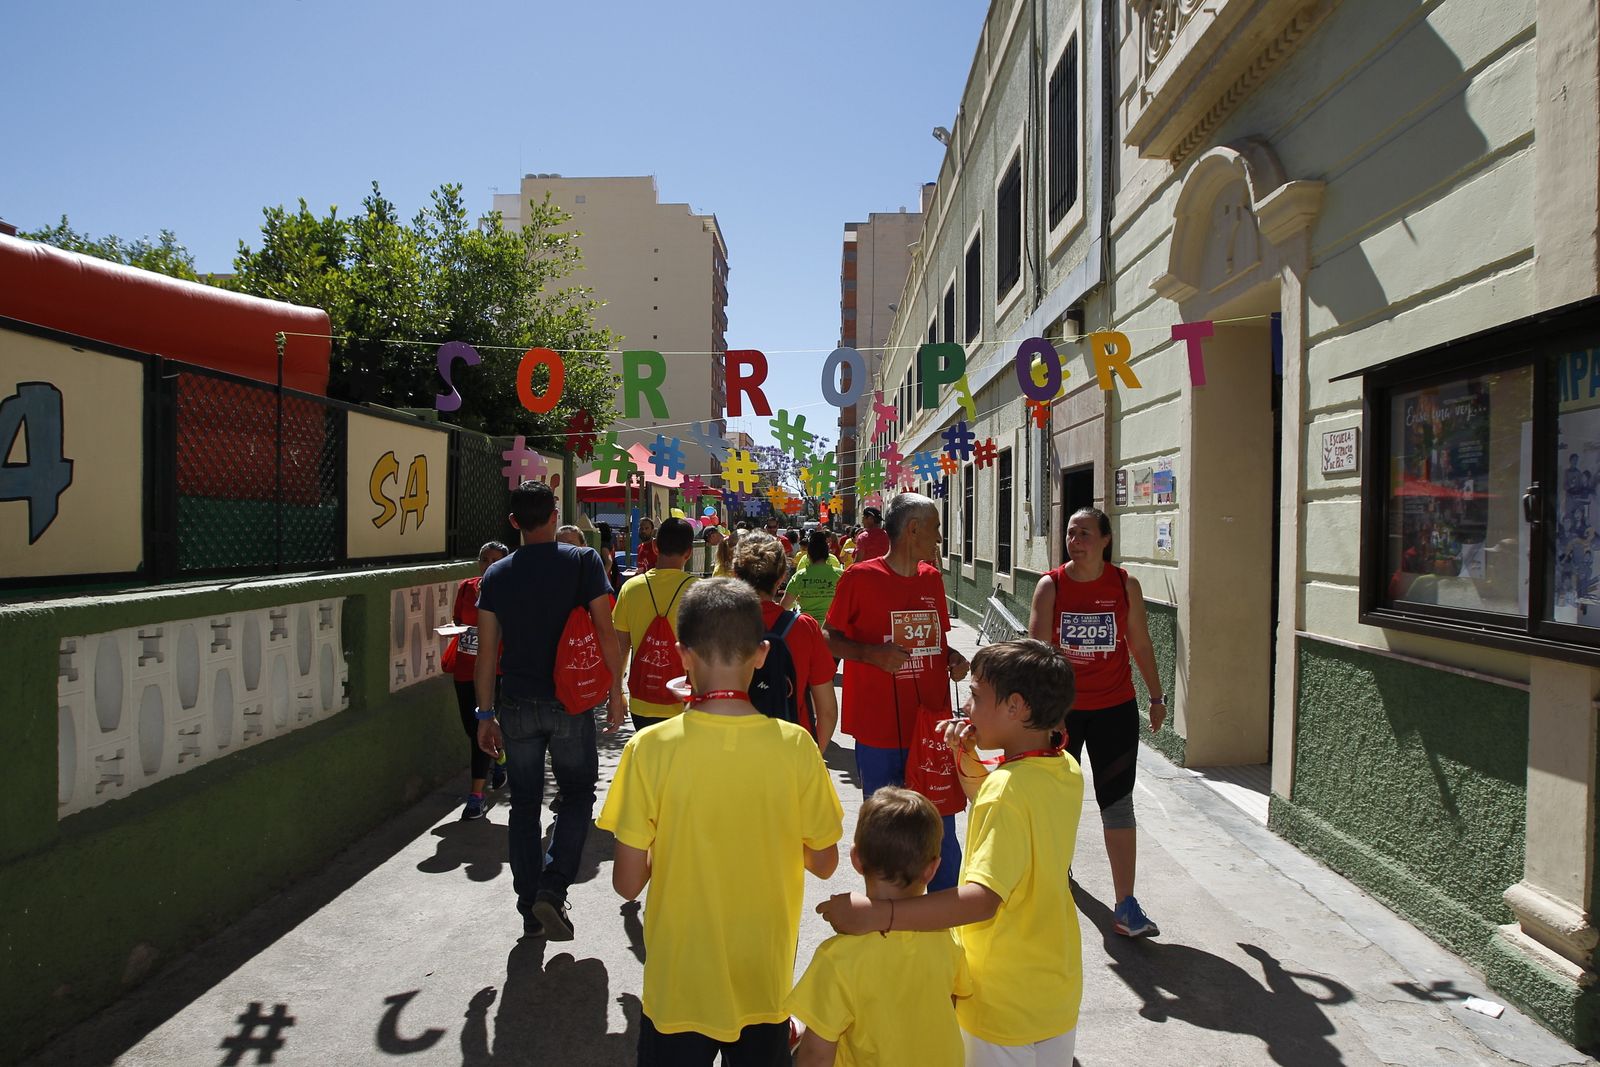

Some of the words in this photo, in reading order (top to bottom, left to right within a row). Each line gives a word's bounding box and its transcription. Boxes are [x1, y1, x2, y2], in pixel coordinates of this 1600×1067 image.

[369, 451, 429, 535] SA
[904, 624, 932, 640] 347
[1066, 625, 1107, 639] 2205
